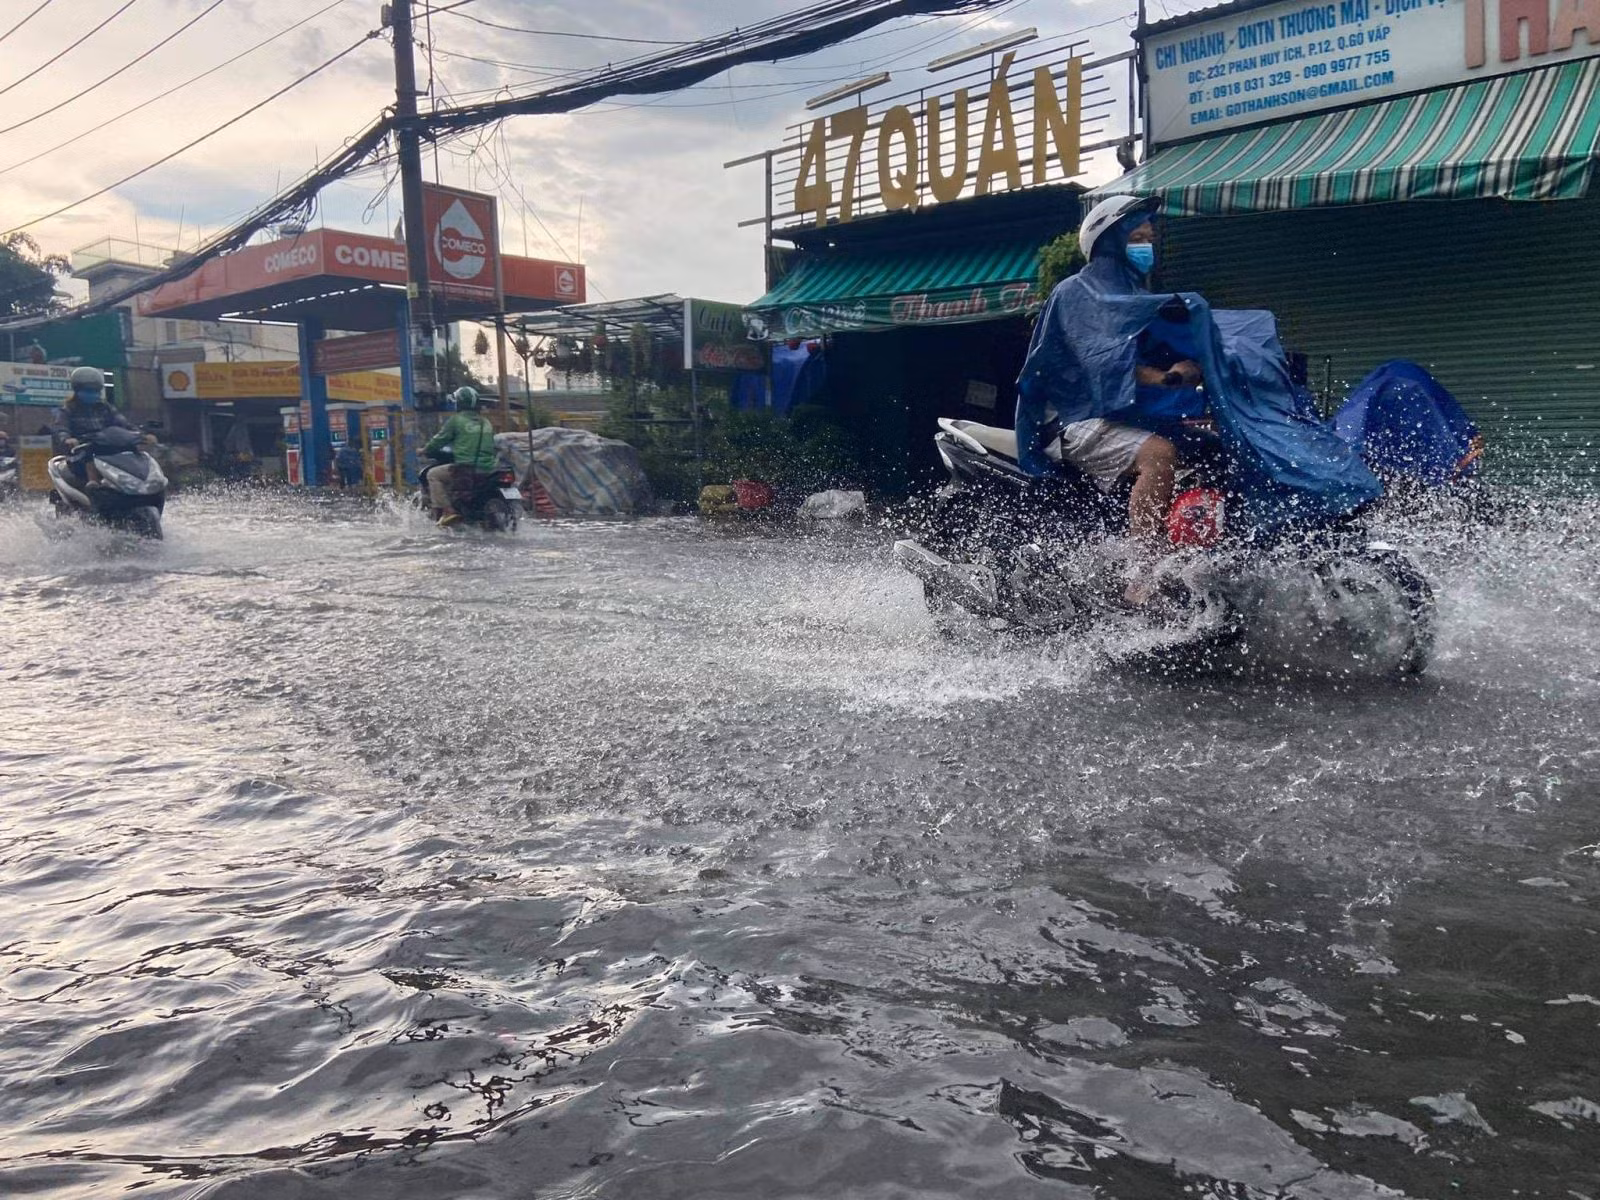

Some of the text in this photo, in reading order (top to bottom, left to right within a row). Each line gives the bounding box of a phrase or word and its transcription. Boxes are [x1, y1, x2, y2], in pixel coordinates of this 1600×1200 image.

[1155, 43, 1177, 70] CHI
[1237, 19, 1275, 50] DNTN
[1279, 6, 1337, 40] THƯƠNG
[1340, 0, 1369, 27] MẠI
[1207, 64, 1226, 79] 232
[1228, 57, 1257, 74] PHAN
[1260, 51, 1281, 67] HUY
[1213, 82, 1241, 99] 0918
[1244, 77, 1265, 92] 031
[1269, 71, 1291, 86] 329
[1303, 63, 1327, 79] 090
[1330, 55, 1362, 73] 9977
[1366, 49, 1390, 66] 755
[1225, 70, 1394, 117] GOTHANHSON@GMAIL.COM
[264, 244, 317, 273] COMECO
[334, 245, 408, 271] COME
[440, 234, 487, 256] COMECO
